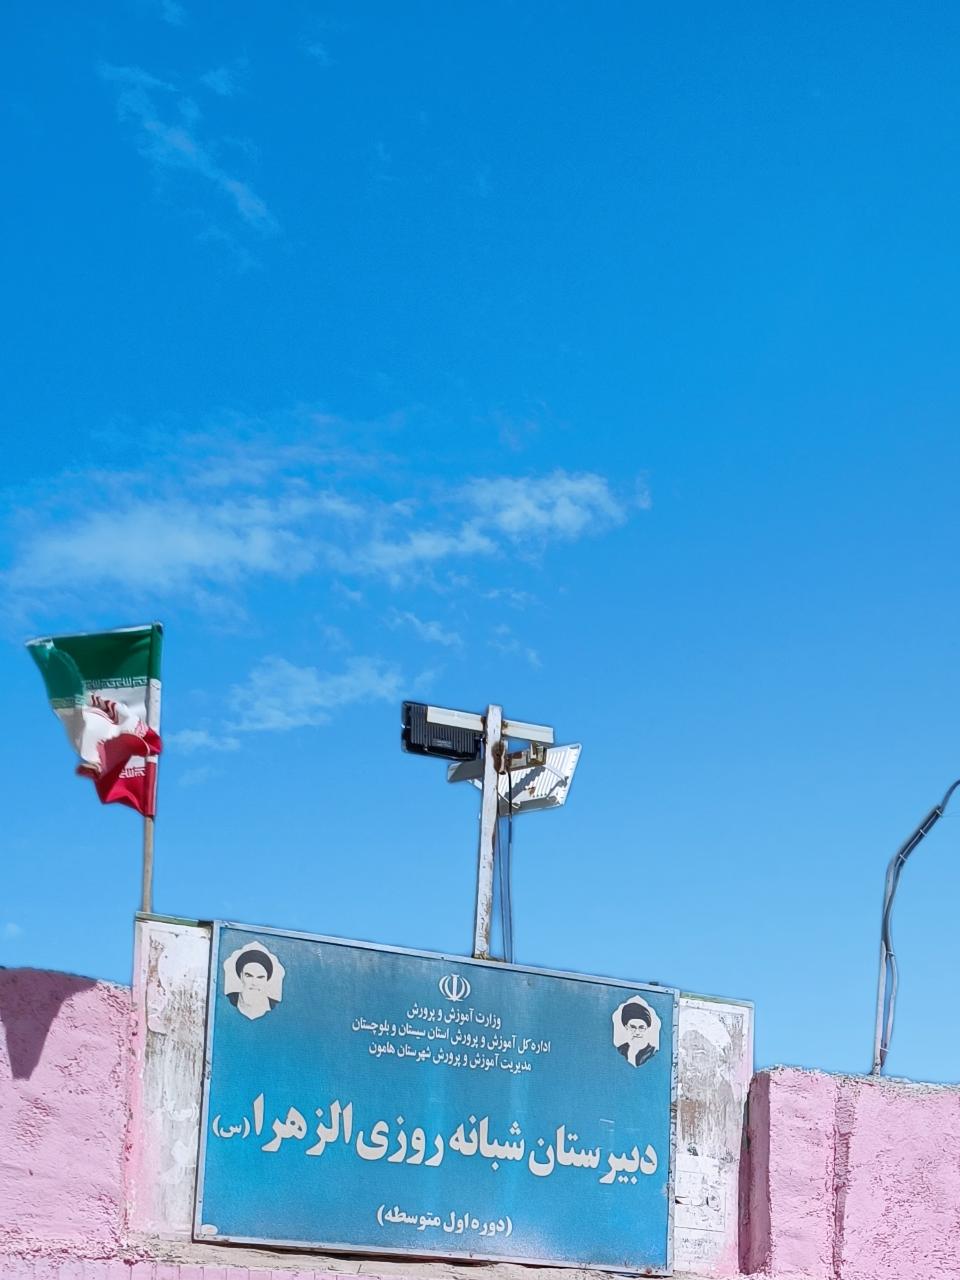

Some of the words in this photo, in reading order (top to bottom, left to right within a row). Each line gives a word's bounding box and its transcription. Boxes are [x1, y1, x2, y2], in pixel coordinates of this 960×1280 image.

[406, 1002, 436, 1022] پرورش
[437, 1008, 443, 1022] و
[444, 1007, 475, 1026] آموزش
[475, 1012, 502, 1030] وزارت
[351, 1017, 390, 1036] بلوچستان
[390, 1024, 397, 1037] و
[398, 1023, 426, 1040] سیستان
[427, 1026, 450, 1040] استان
[450, 1028, 479, 1049] پرورش
[480, 1035, 486, 1048] و
[486, 1033, 517, 1053] آموزش
[368, 1041, 396, 1058] هامون
[396, 1044, 431, 1062] شهرستان
[432, 1047, 461, 1067] پرورش
[462, 1053, 468, 1067] و
[469, 1052, 500, 1071] آموزش
[500, 1059, 532, 1075] مدیریت
[212, 1113, 251, 1139] (س)
[253, 1092, 353, 1156] الزهرا
[356, 1114, 445, 1167] روزی
[449, 1114, 525, 1172] شبانه
[528, 1124, 658, 1185] دبیرستان
[376, 1204, 441, 1231] متوسطه)
[443, 1211, 470, 1234] اول
[471, 1215, 513, 1238] (دوره
